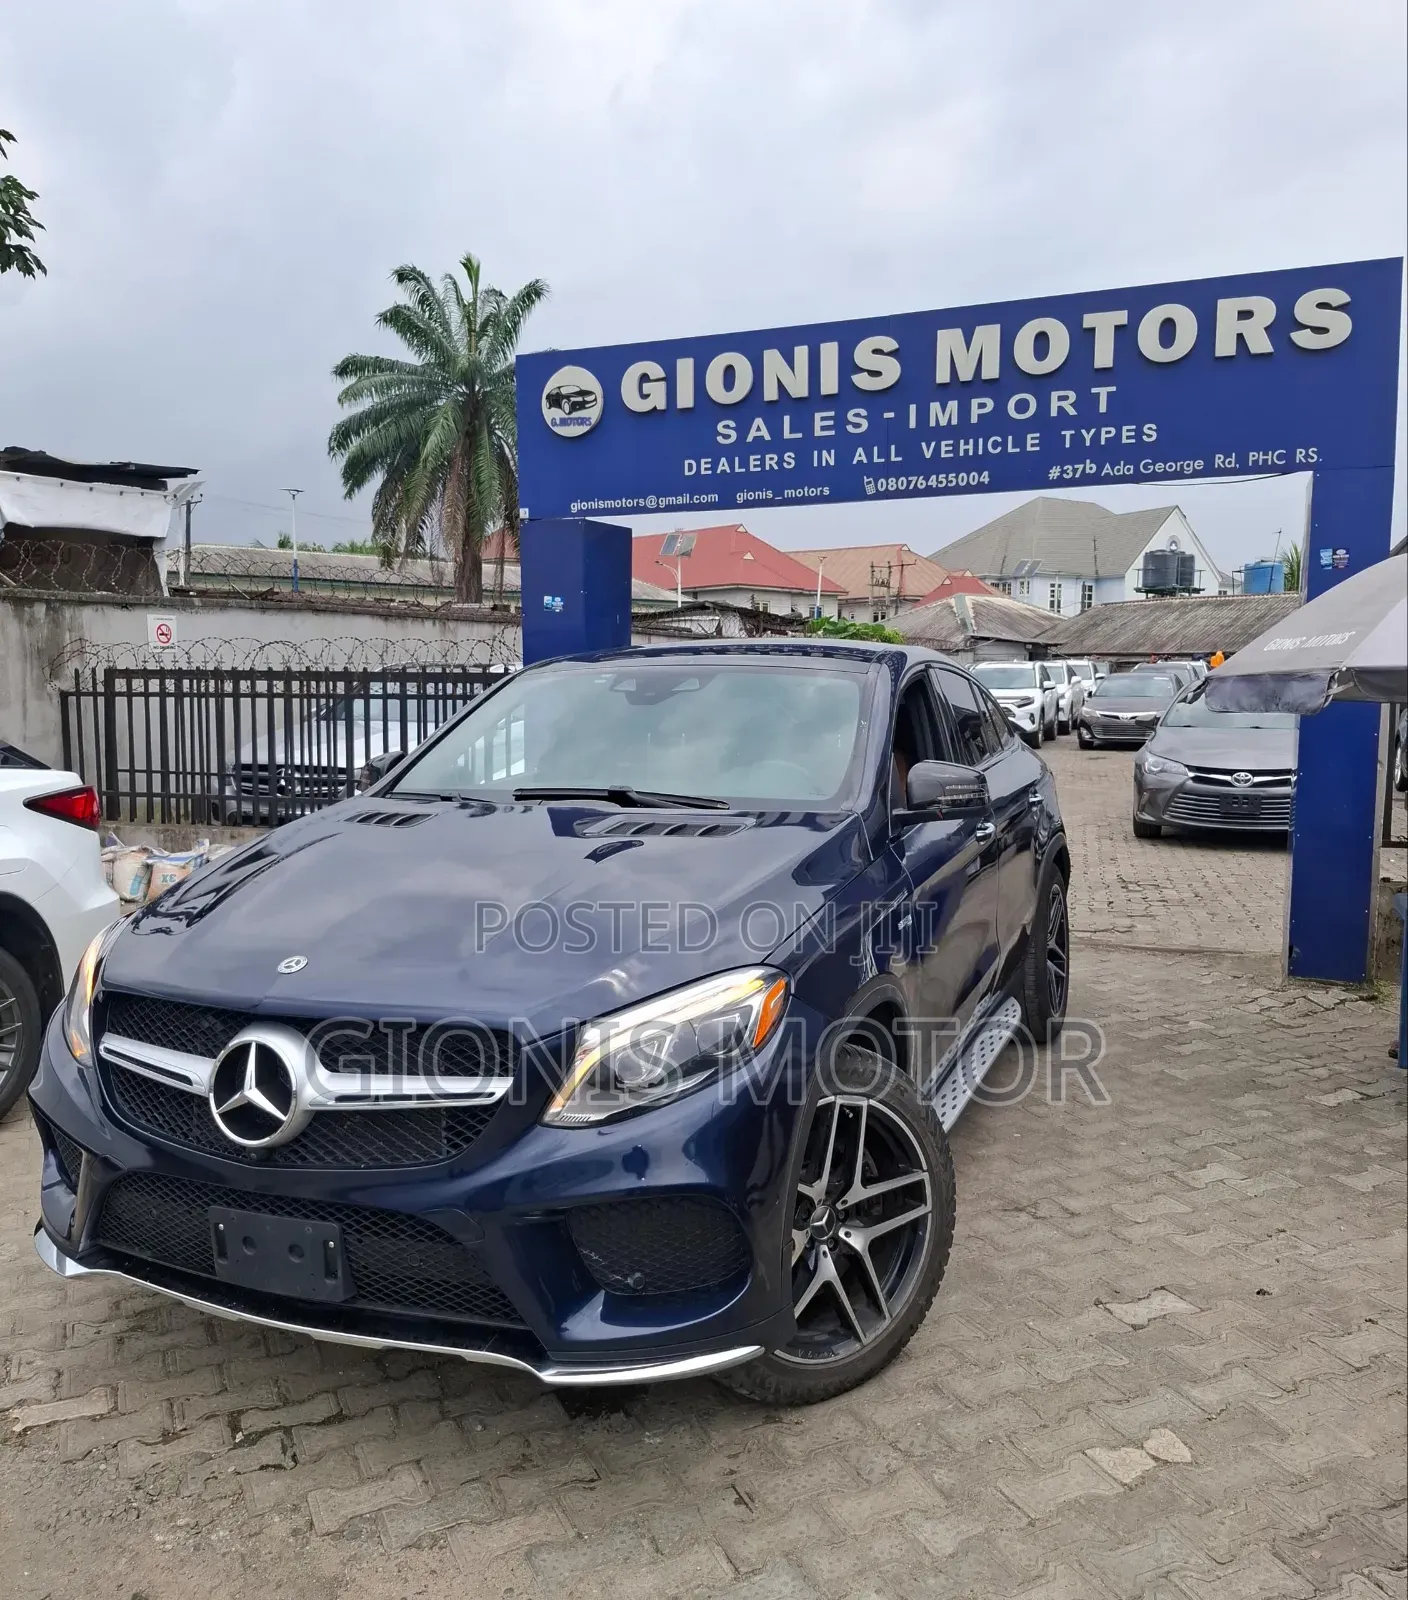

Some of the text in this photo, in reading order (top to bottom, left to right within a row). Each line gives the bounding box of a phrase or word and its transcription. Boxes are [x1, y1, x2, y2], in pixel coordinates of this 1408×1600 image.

[620, 287, 1354, 414] GIONIS MOTORS
[550, 416, 593, 428] G.MOTORS
[684, 423, 1159, 477] DEALERS IN ALL VEHICLE TYPES
[1048, 447, 1324, 480] #37b Ada George Rd, PHC RS.
[876, 470, 991, 492] 08076455004
[570, 492, 719, 514] gionismotors@gmail.com
